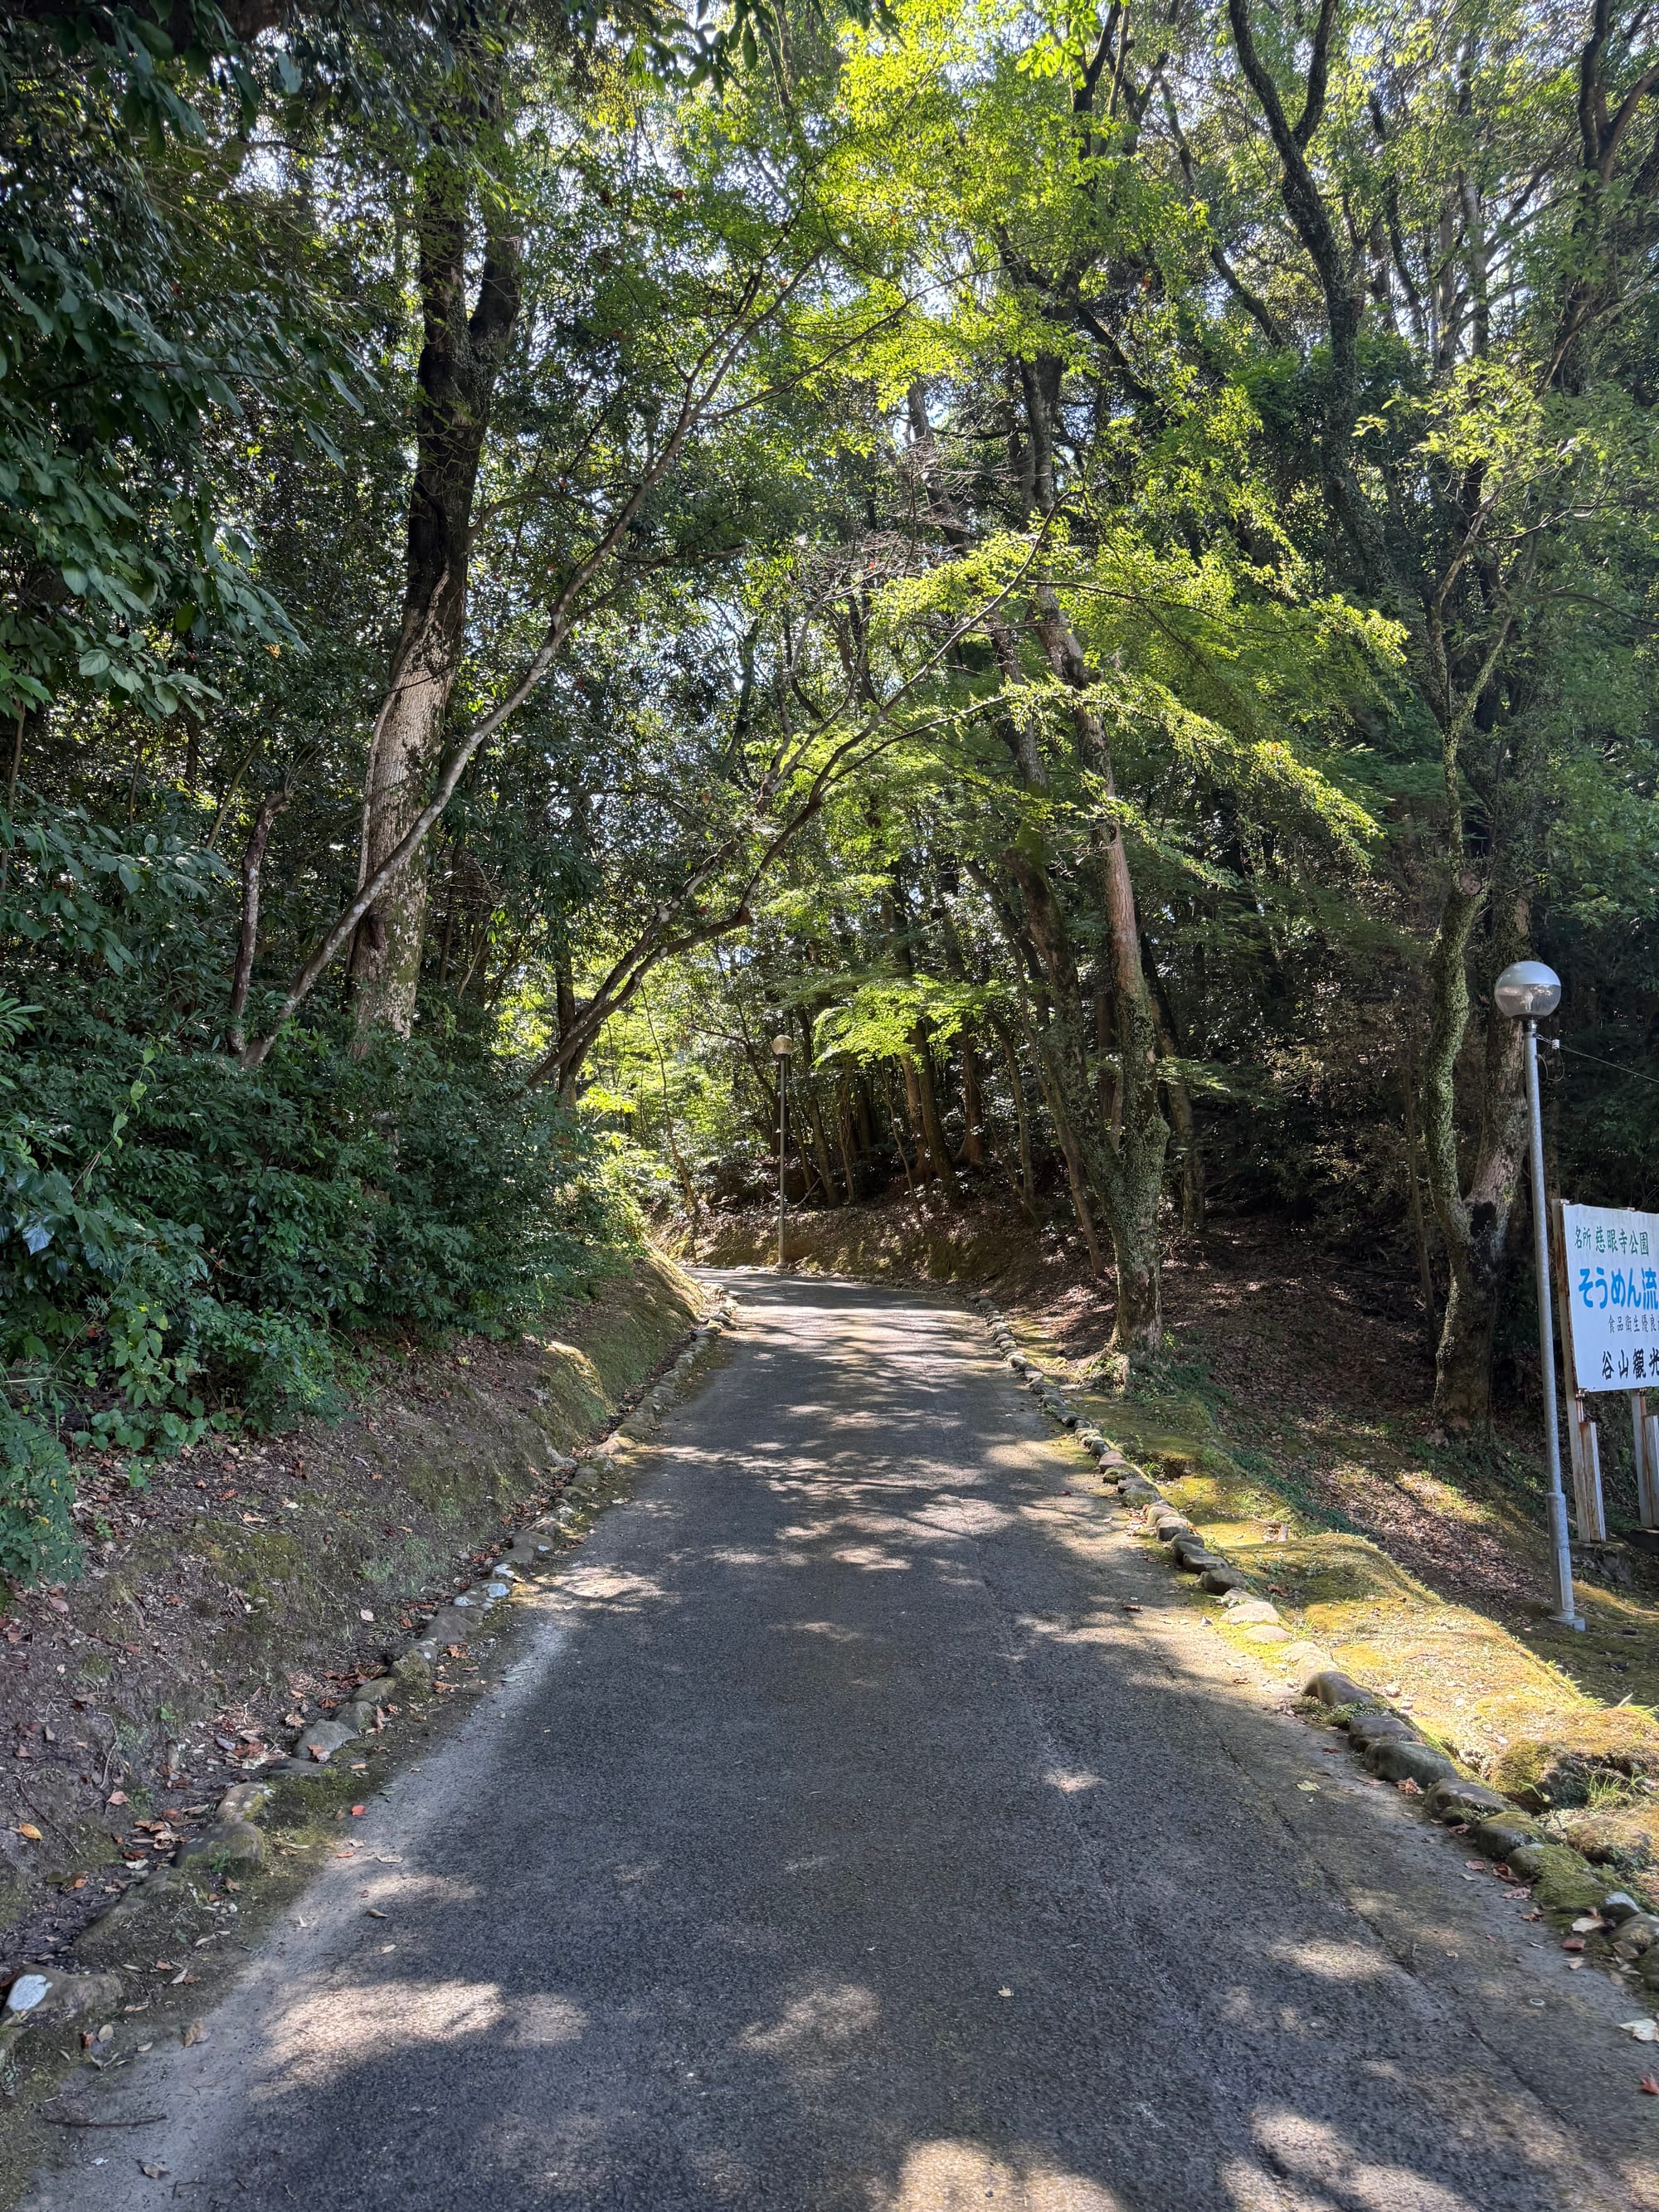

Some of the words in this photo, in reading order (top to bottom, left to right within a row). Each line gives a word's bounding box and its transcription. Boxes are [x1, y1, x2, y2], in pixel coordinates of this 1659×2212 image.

[1608, 1314, 1659, 1334] 食品衛生優良
